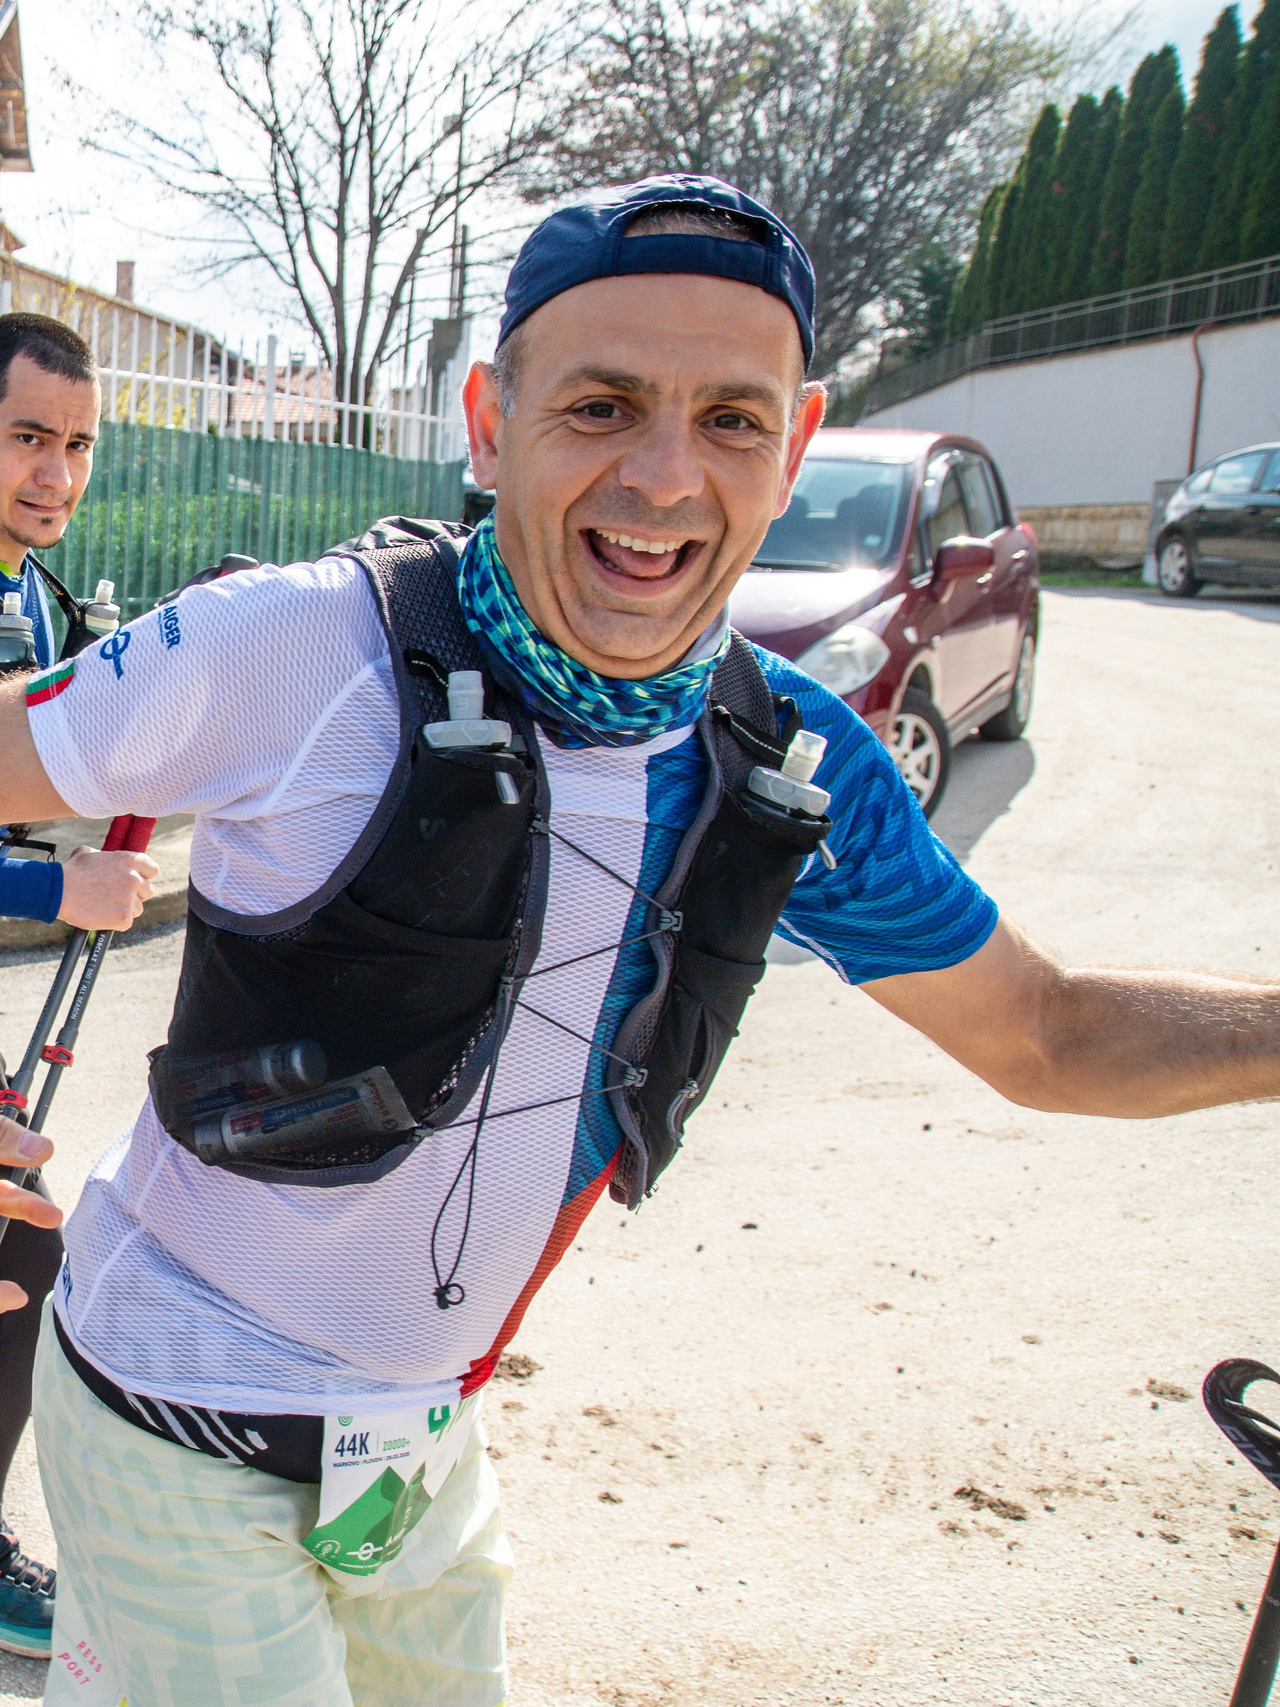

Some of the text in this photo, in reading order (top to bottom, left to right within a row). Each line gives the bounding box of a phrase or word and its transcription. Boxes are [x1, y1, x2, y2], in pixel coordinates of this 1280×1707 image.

[91, 933, 106, 962] FORCLAZ
[334, 1431, 370, 1458] 44K
[57, 1652, 91, 1685] PORT
